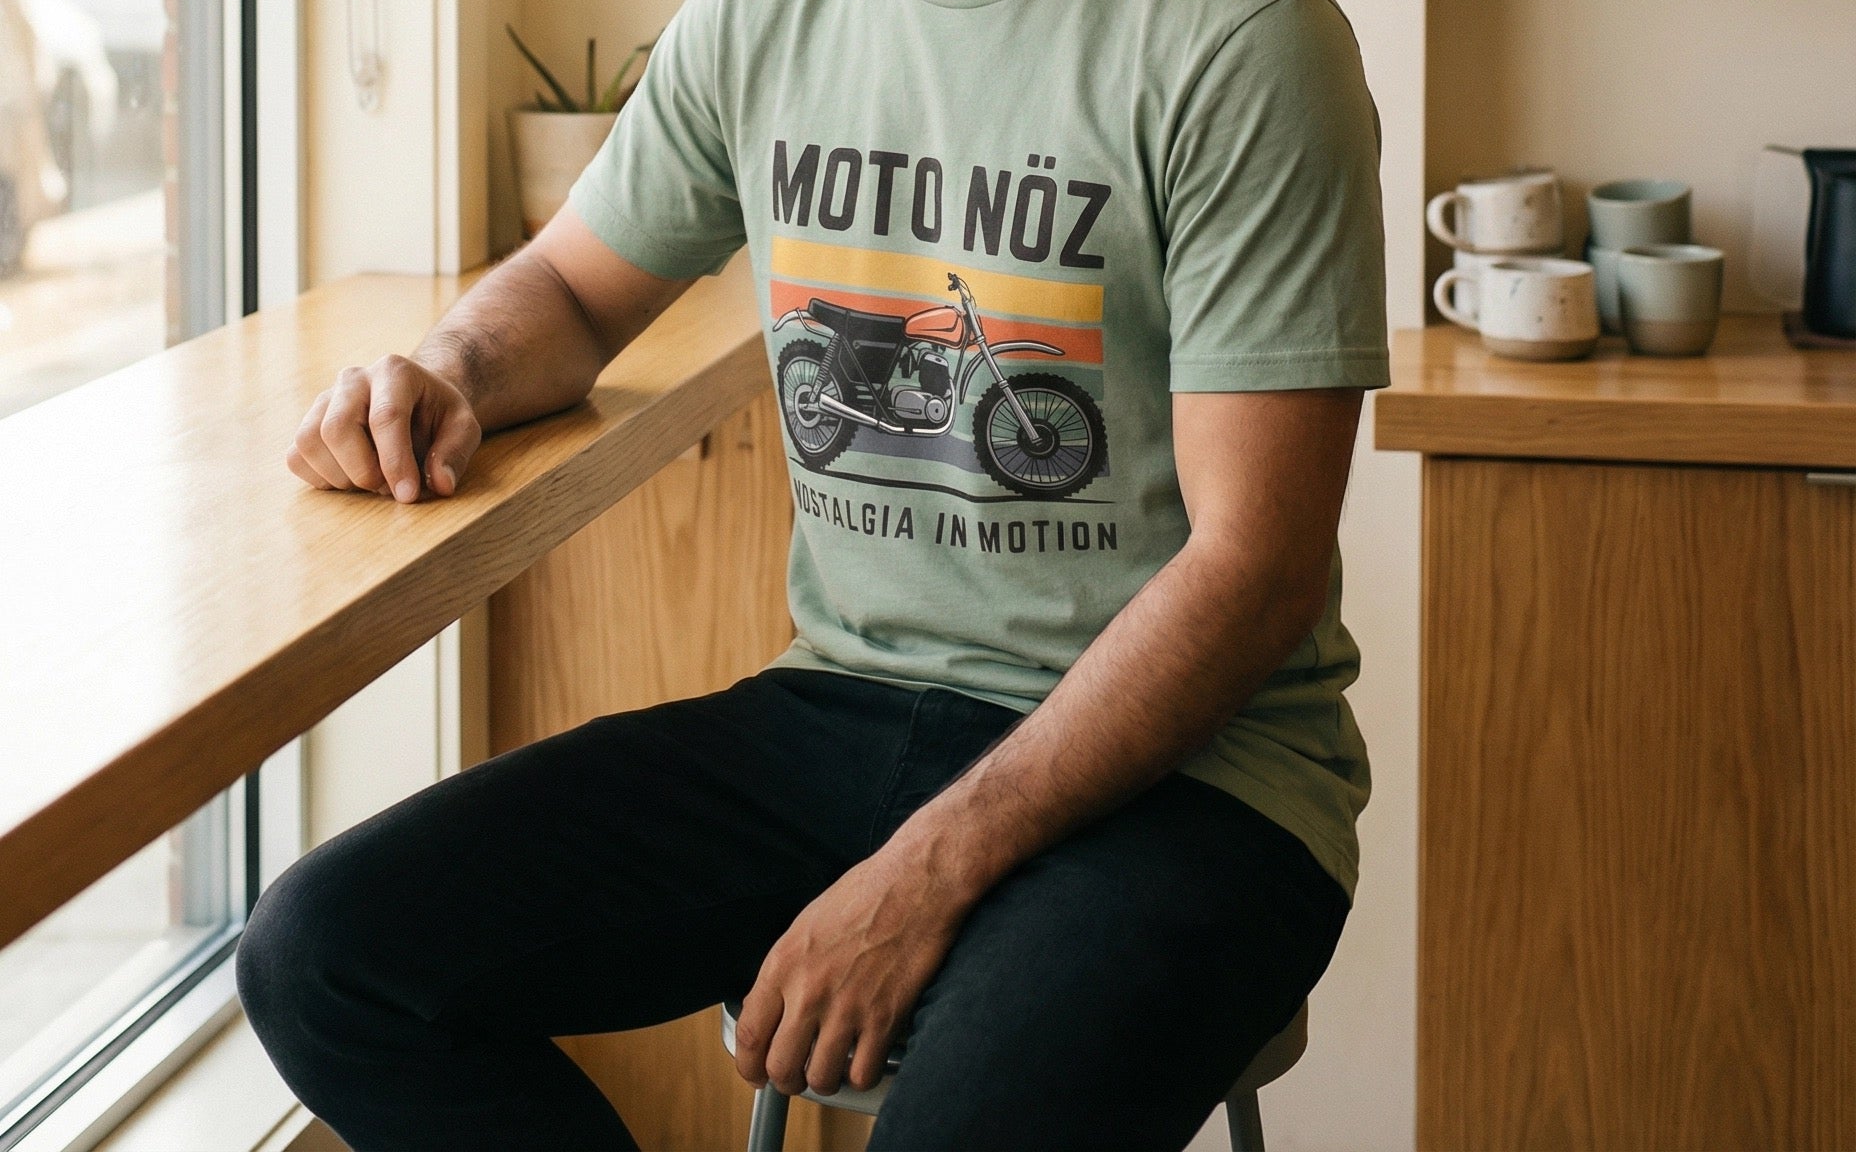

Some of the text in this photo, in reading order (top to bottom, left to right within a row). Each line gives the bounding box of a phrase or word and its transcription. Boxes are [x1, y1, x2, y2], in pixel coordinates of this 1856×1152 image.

[773, 140, 1111, 268] MOTO NÖZ
[794, 478, 1118, 554] NOSTALGIA IN MOTION
